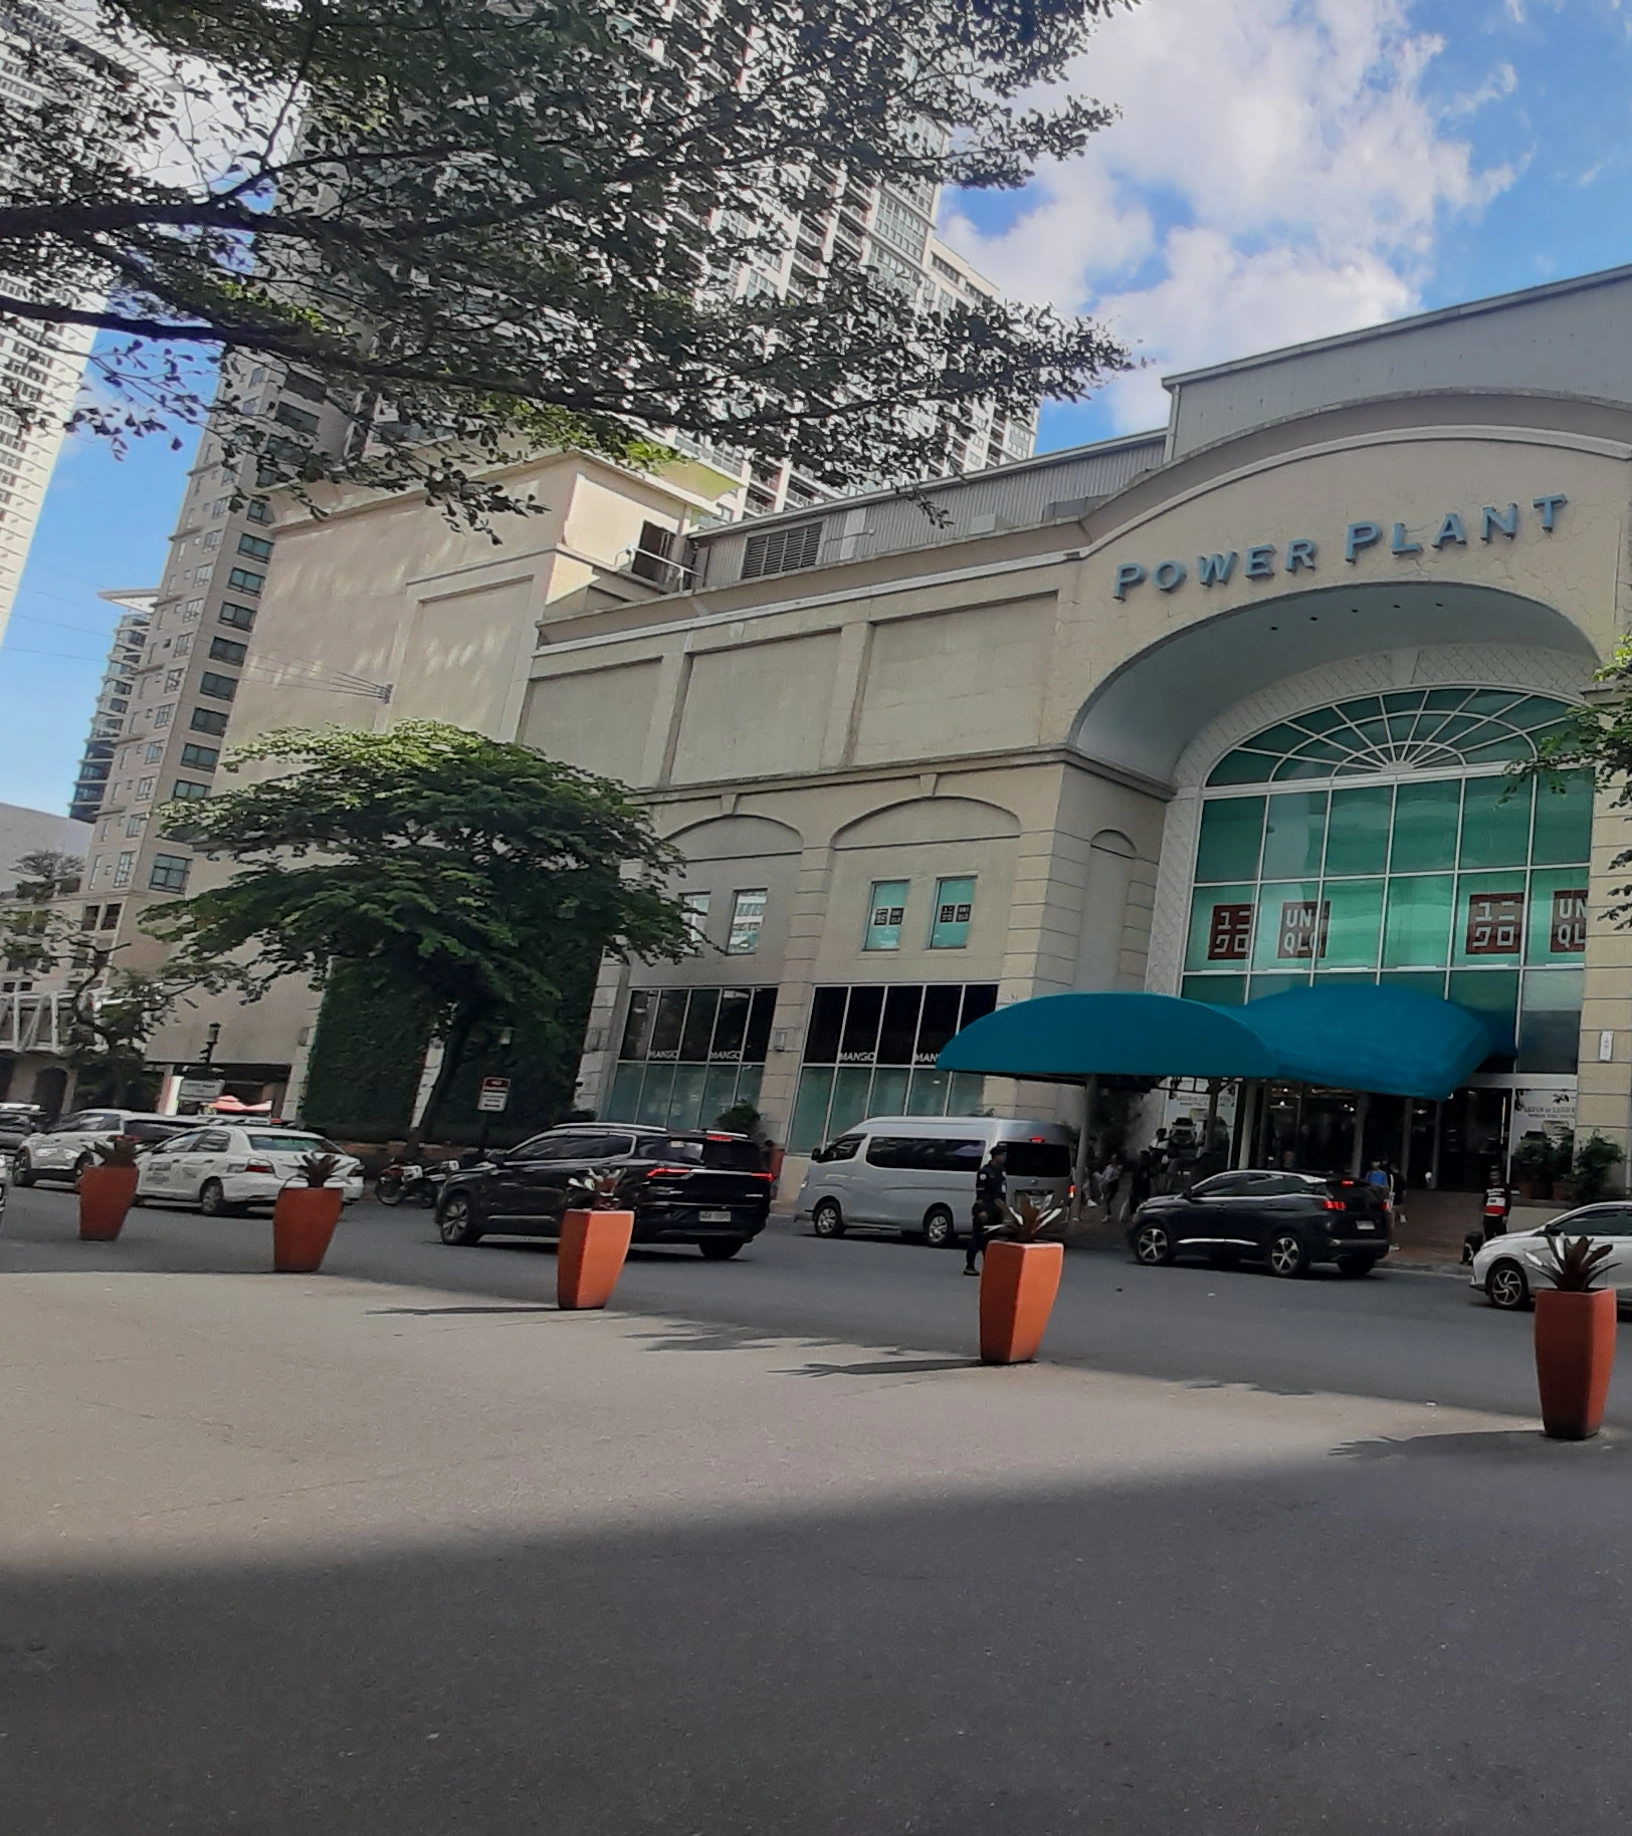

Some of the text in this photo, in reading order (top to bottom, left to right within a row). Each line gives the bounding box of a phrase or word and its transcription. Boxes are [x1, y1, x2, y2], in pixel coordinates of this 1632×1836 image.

[1112, 493, 1569, 602] POWER PLANT
[1285, 908, 1316, 929] UN
[1559, 897, 1588, 920] UN
[1557, 922, 1587, 950] QL
[840, 1052, 877, 1062] MANGO
[915, 1053, 942, 1063] MAN
